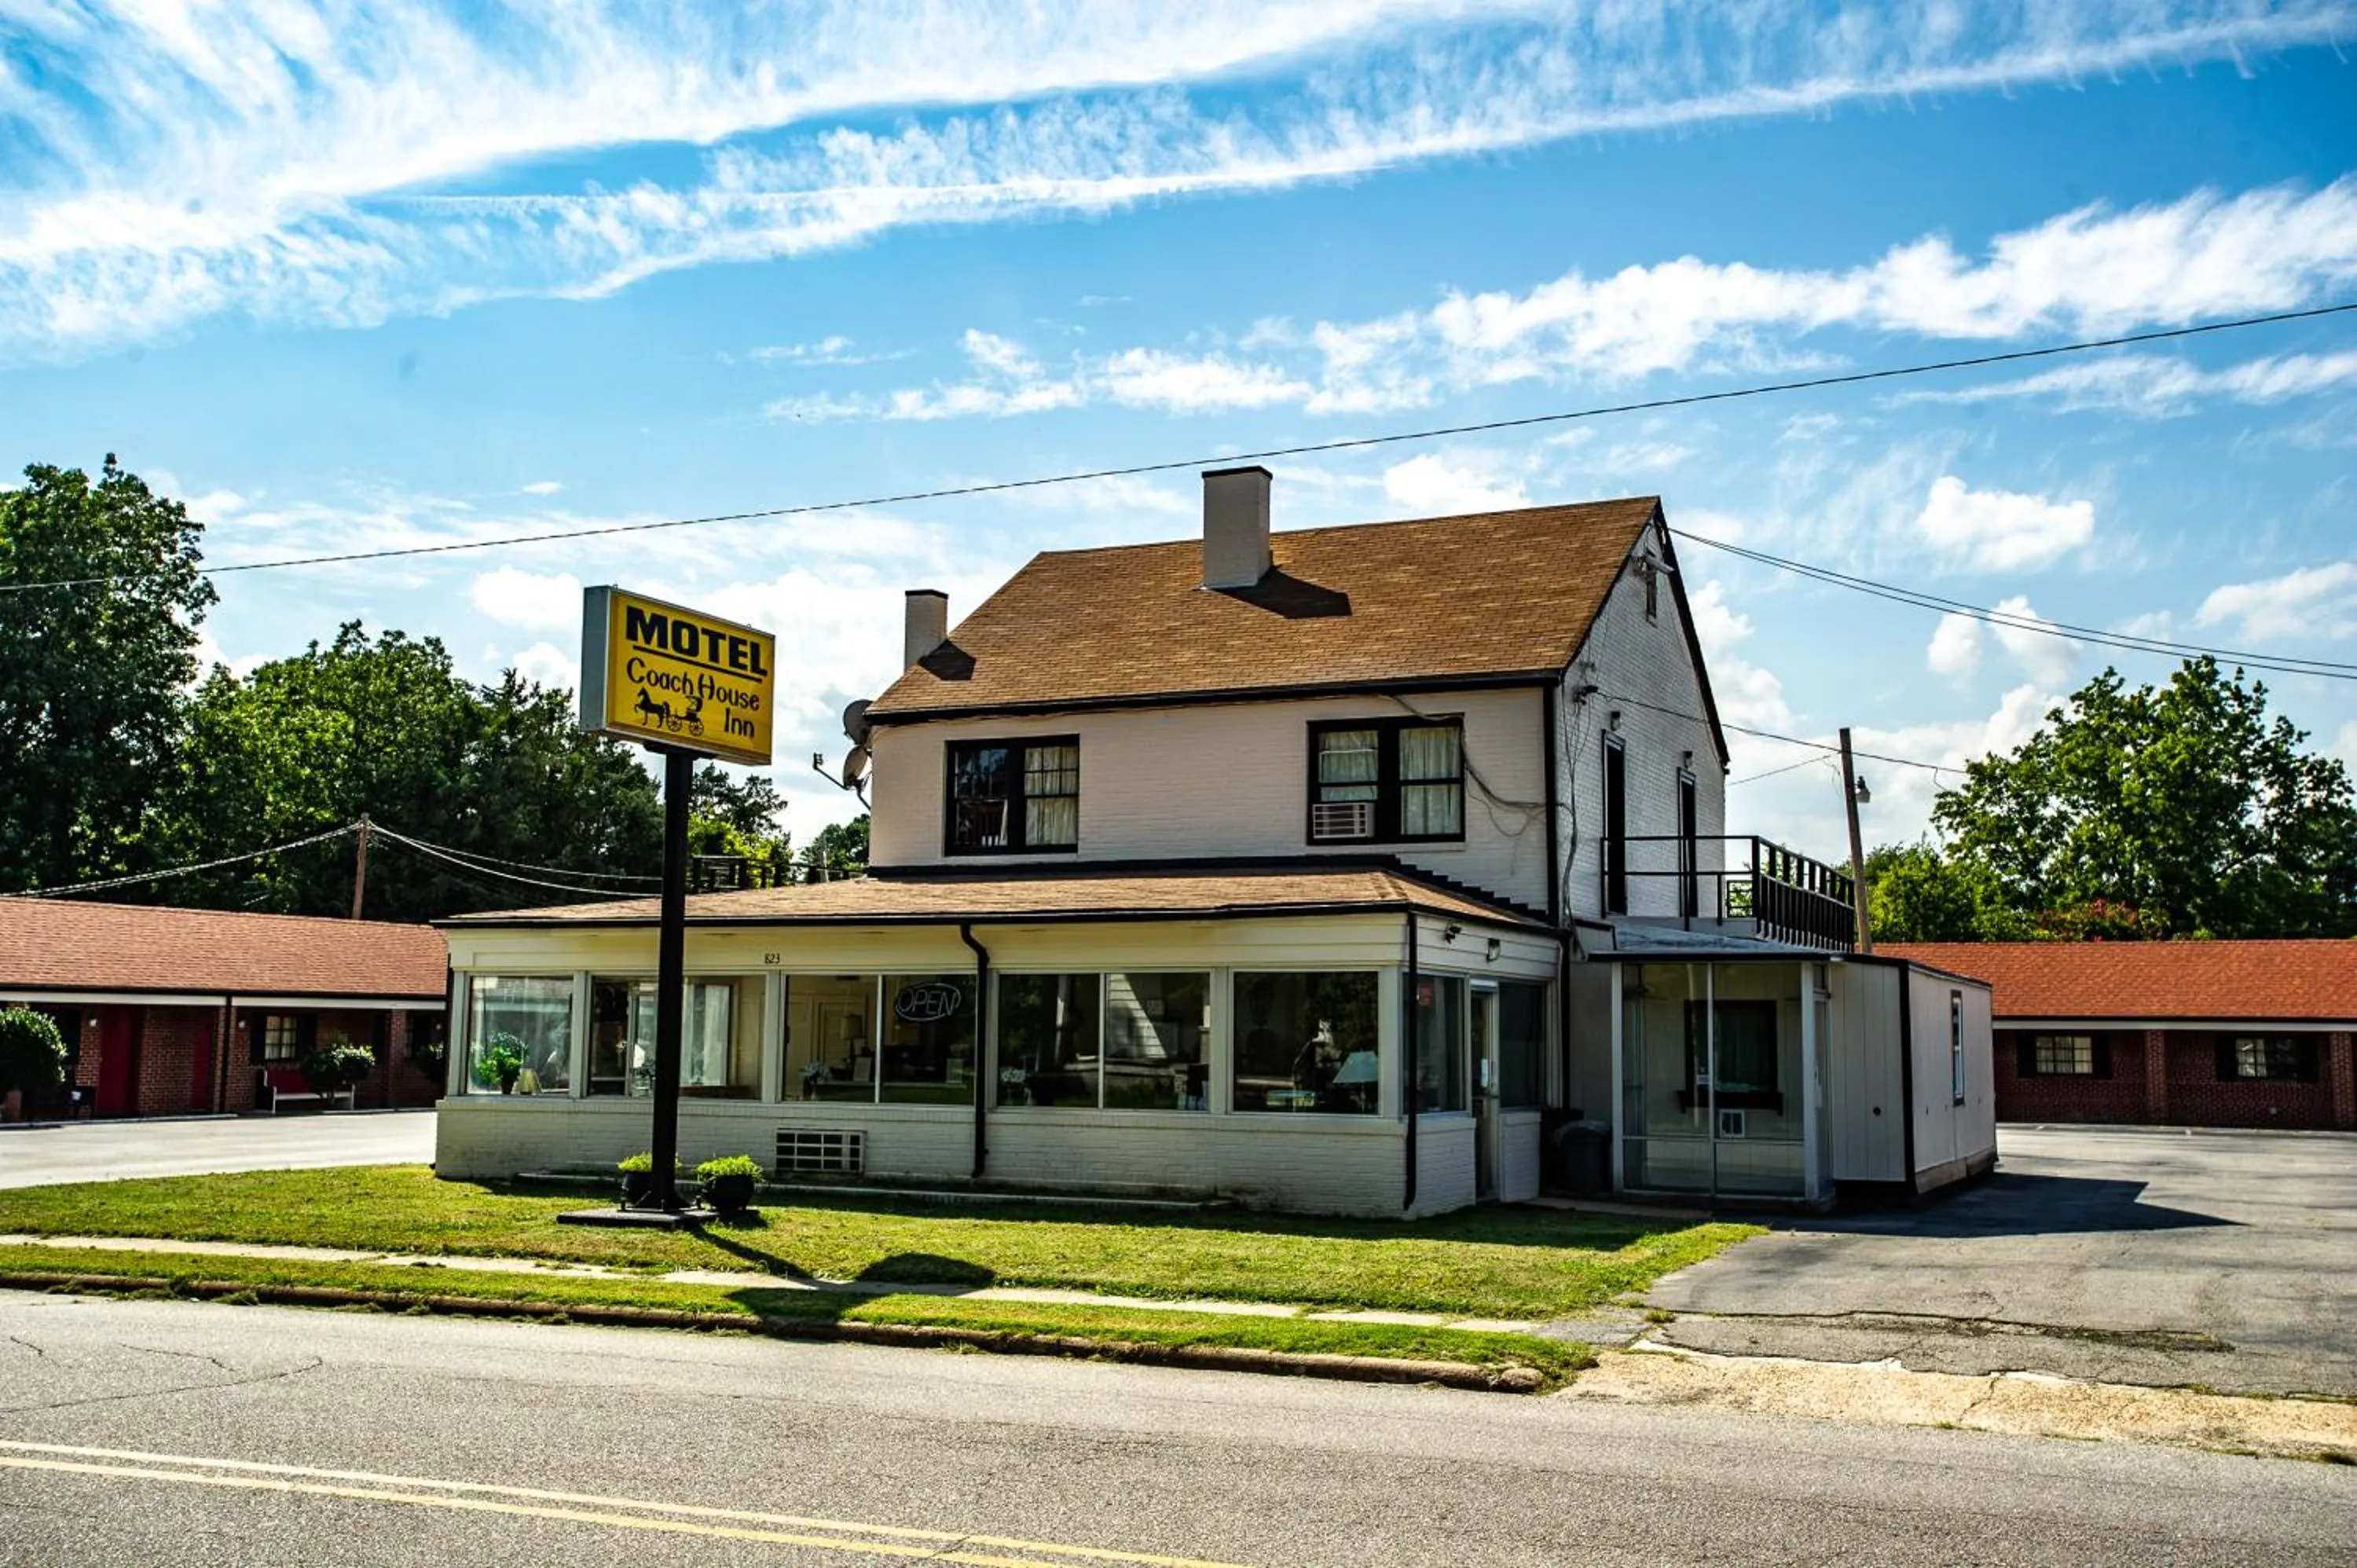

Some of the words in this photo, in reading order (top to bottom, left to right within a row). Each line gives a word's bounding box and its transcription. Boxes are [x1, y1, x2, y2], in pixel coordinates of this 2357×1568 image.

[626, 605, 767, 676] MOTEL
[626, 657, 694, 695] Coach
[698, 673, 760, 711] House
[724, 708, 755, 738] Inn
[898, 989, 957, 1017] OPEN
